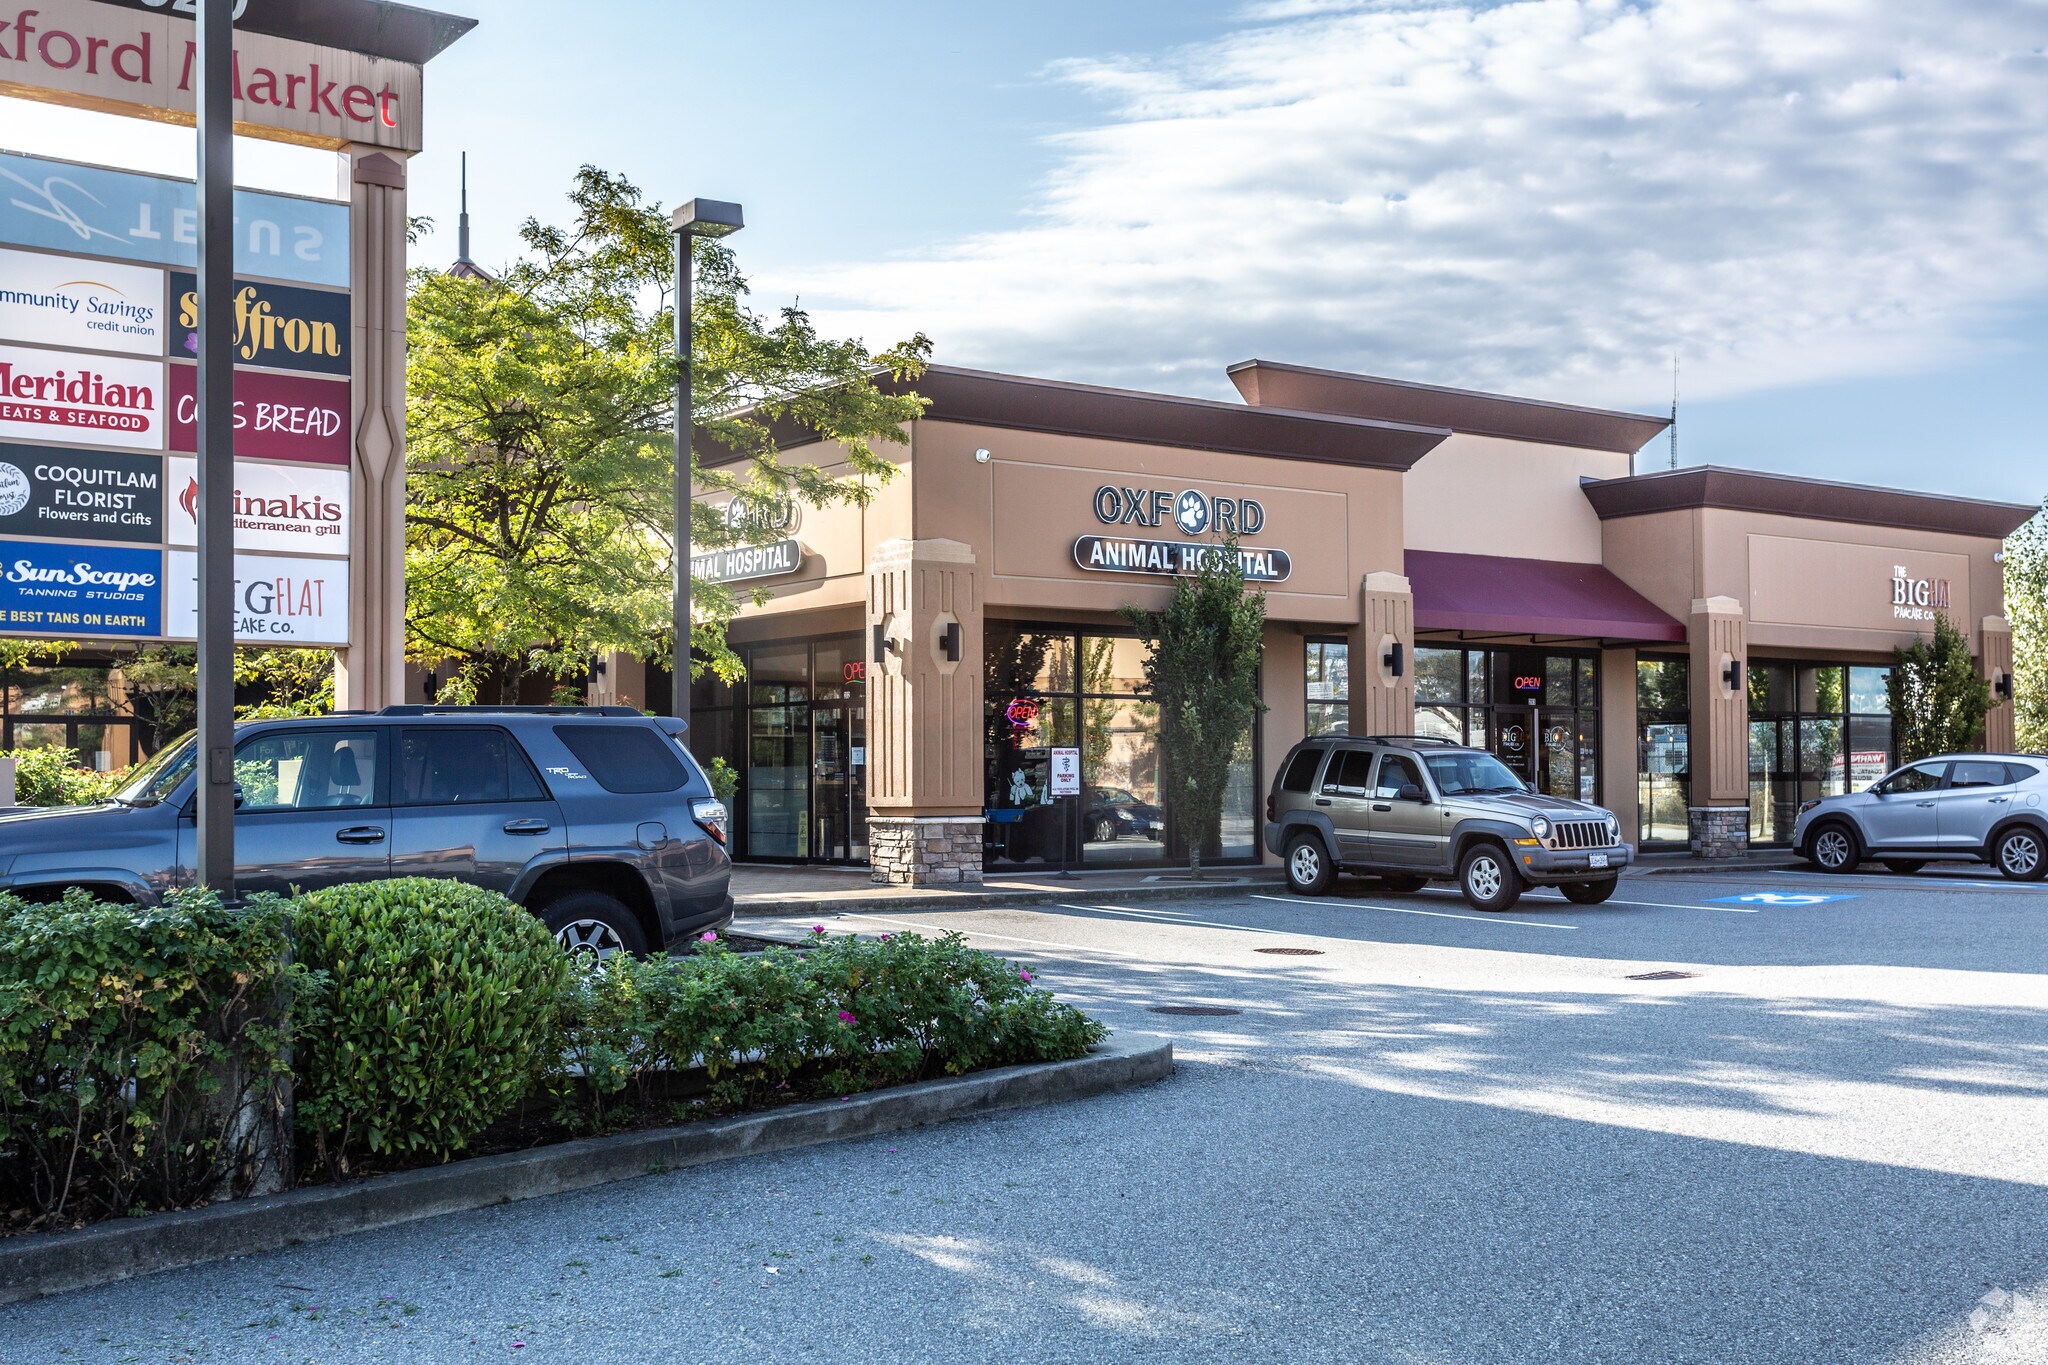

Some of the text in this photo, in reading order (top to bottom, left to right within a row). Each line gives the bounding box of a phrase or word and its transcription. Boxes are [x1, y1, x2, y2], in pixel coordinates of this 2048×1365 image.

[86, 296, 154, 324] Savings
[86, 320, 155, 336] credit union
[48, 410, 60, 422] &
[67, 412, 141, 429] SEAFOOD
[176, 394, 341, 437] CS BREAD
[34, 464, 157, 489] COQUITLAM
[55, 489, 136, 509] FLORIST
[233, 489, 342, 522] inakis
[38, 507, 152, 526] Flowers and Gifts
[315, 524, 341, 536] grill
[725, 544, 791, 577] HOSPITAL
[1089, 540, 1174, 570] ANIMAL
[6, 559, 156, 591] SunScape
[1893, 565, 1907, 578] THE
[18, 587, 145, 601] TANNING STUDIOS
[276, 577, 325, 617] FLAT
[1891, 577, 1930, 606] BIG
[10, 610, 43, 622] BEST
[46, 612, 80, 624] TANS
[83, 614, 101, 625] ON
[104, 615, 146, 627] EARTH
[843, 661, 866, 681] OPE
[1515, 677, 1541, 689] OPEN
[1010, 706, 1038, 718] OPEN
